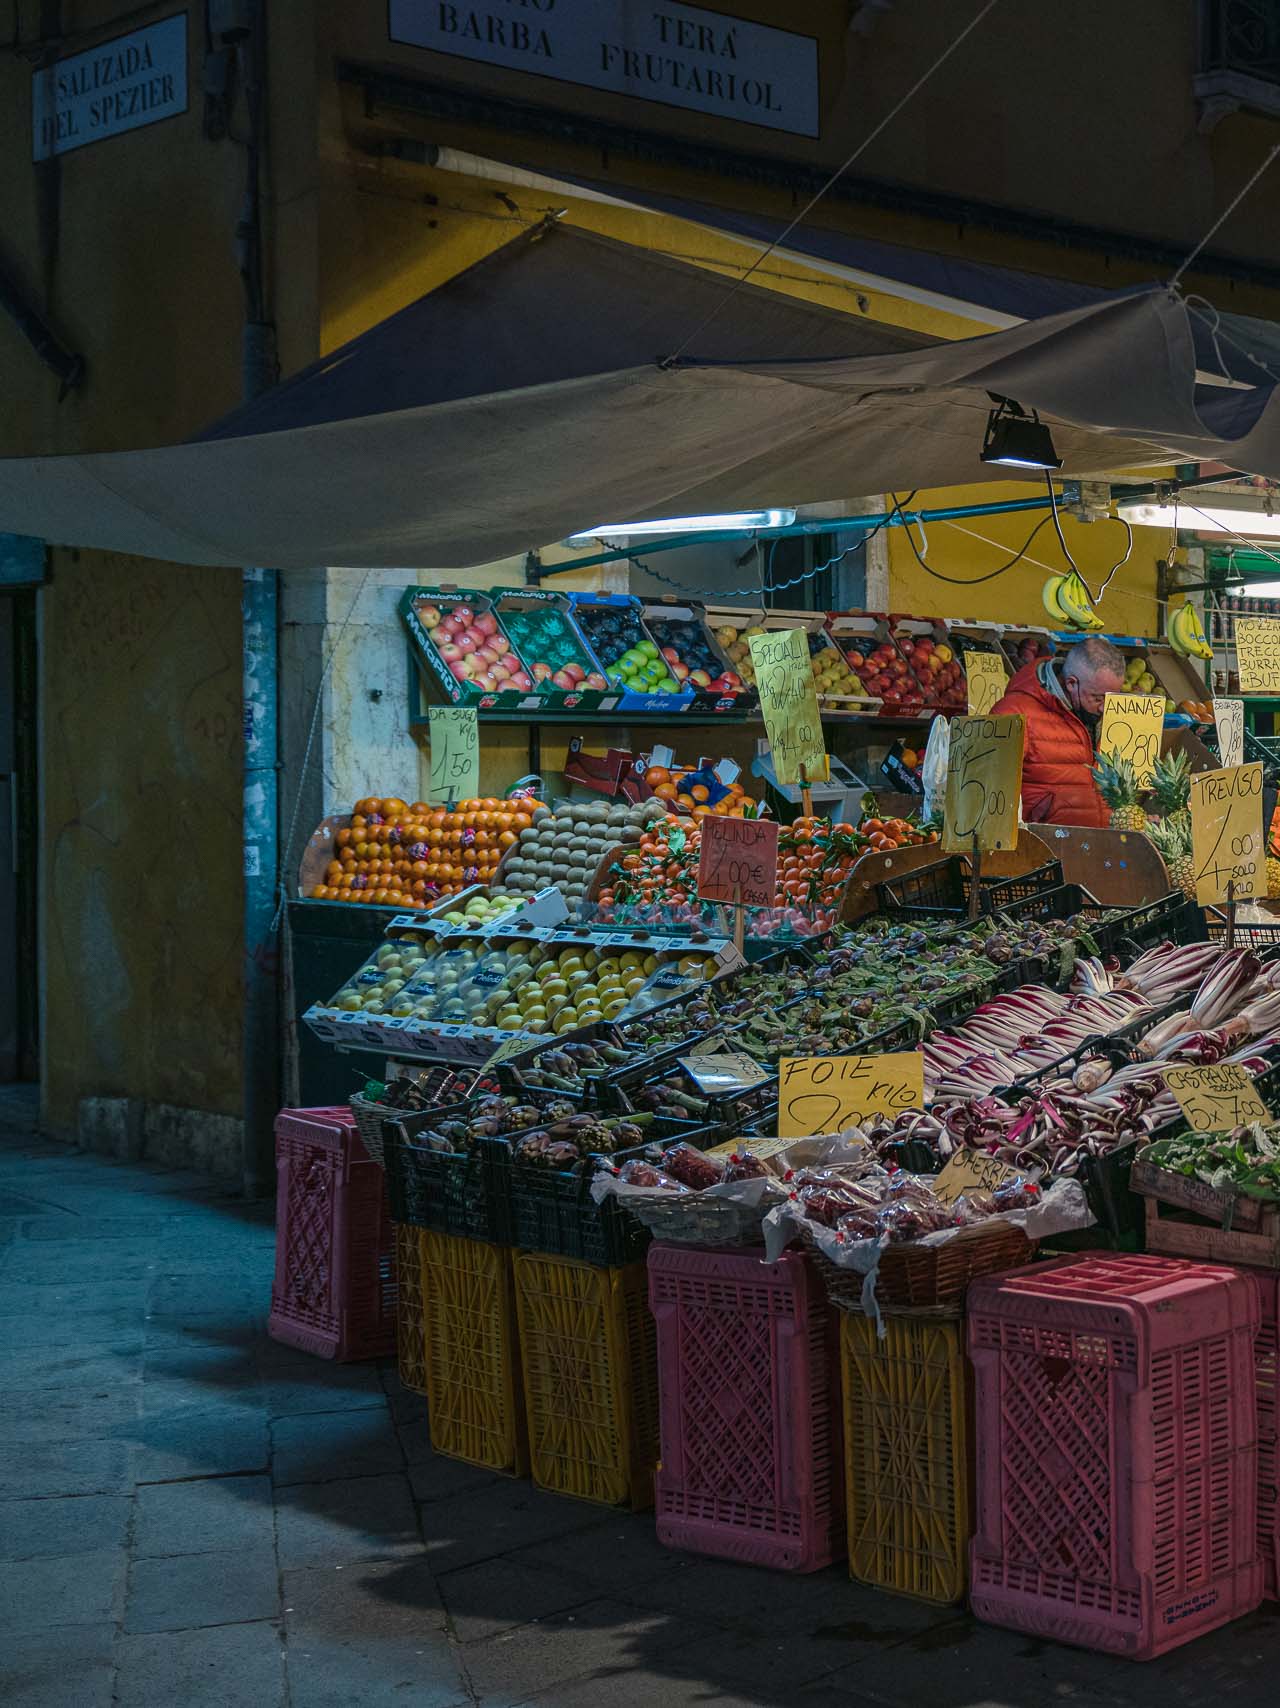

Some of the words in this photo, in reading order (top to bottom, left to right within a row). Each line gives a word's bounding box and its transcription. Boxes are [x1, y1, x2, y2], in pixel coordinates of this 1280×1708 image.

[438, 3, 553, 57] BARBA
[58, 40, 153, 97] SALIZADA
[600, 43, 782, 111] FRUTARIOL
[43, 110, 79, 144] DEL
[89, 74, 175, 128] SPEZIER
[429, 709, 446, 720] DA
[451, 709, 477, 723] SUGO
[1105, 698, 1164, 718] ANANAS
[949, 716, 1013, 746] BOTOLI
[1192, 767, 1263, 806] TREVISO
[1231, 862, 1257, 879] SOLO
[784, 1055, 879, 1085] FOIE
